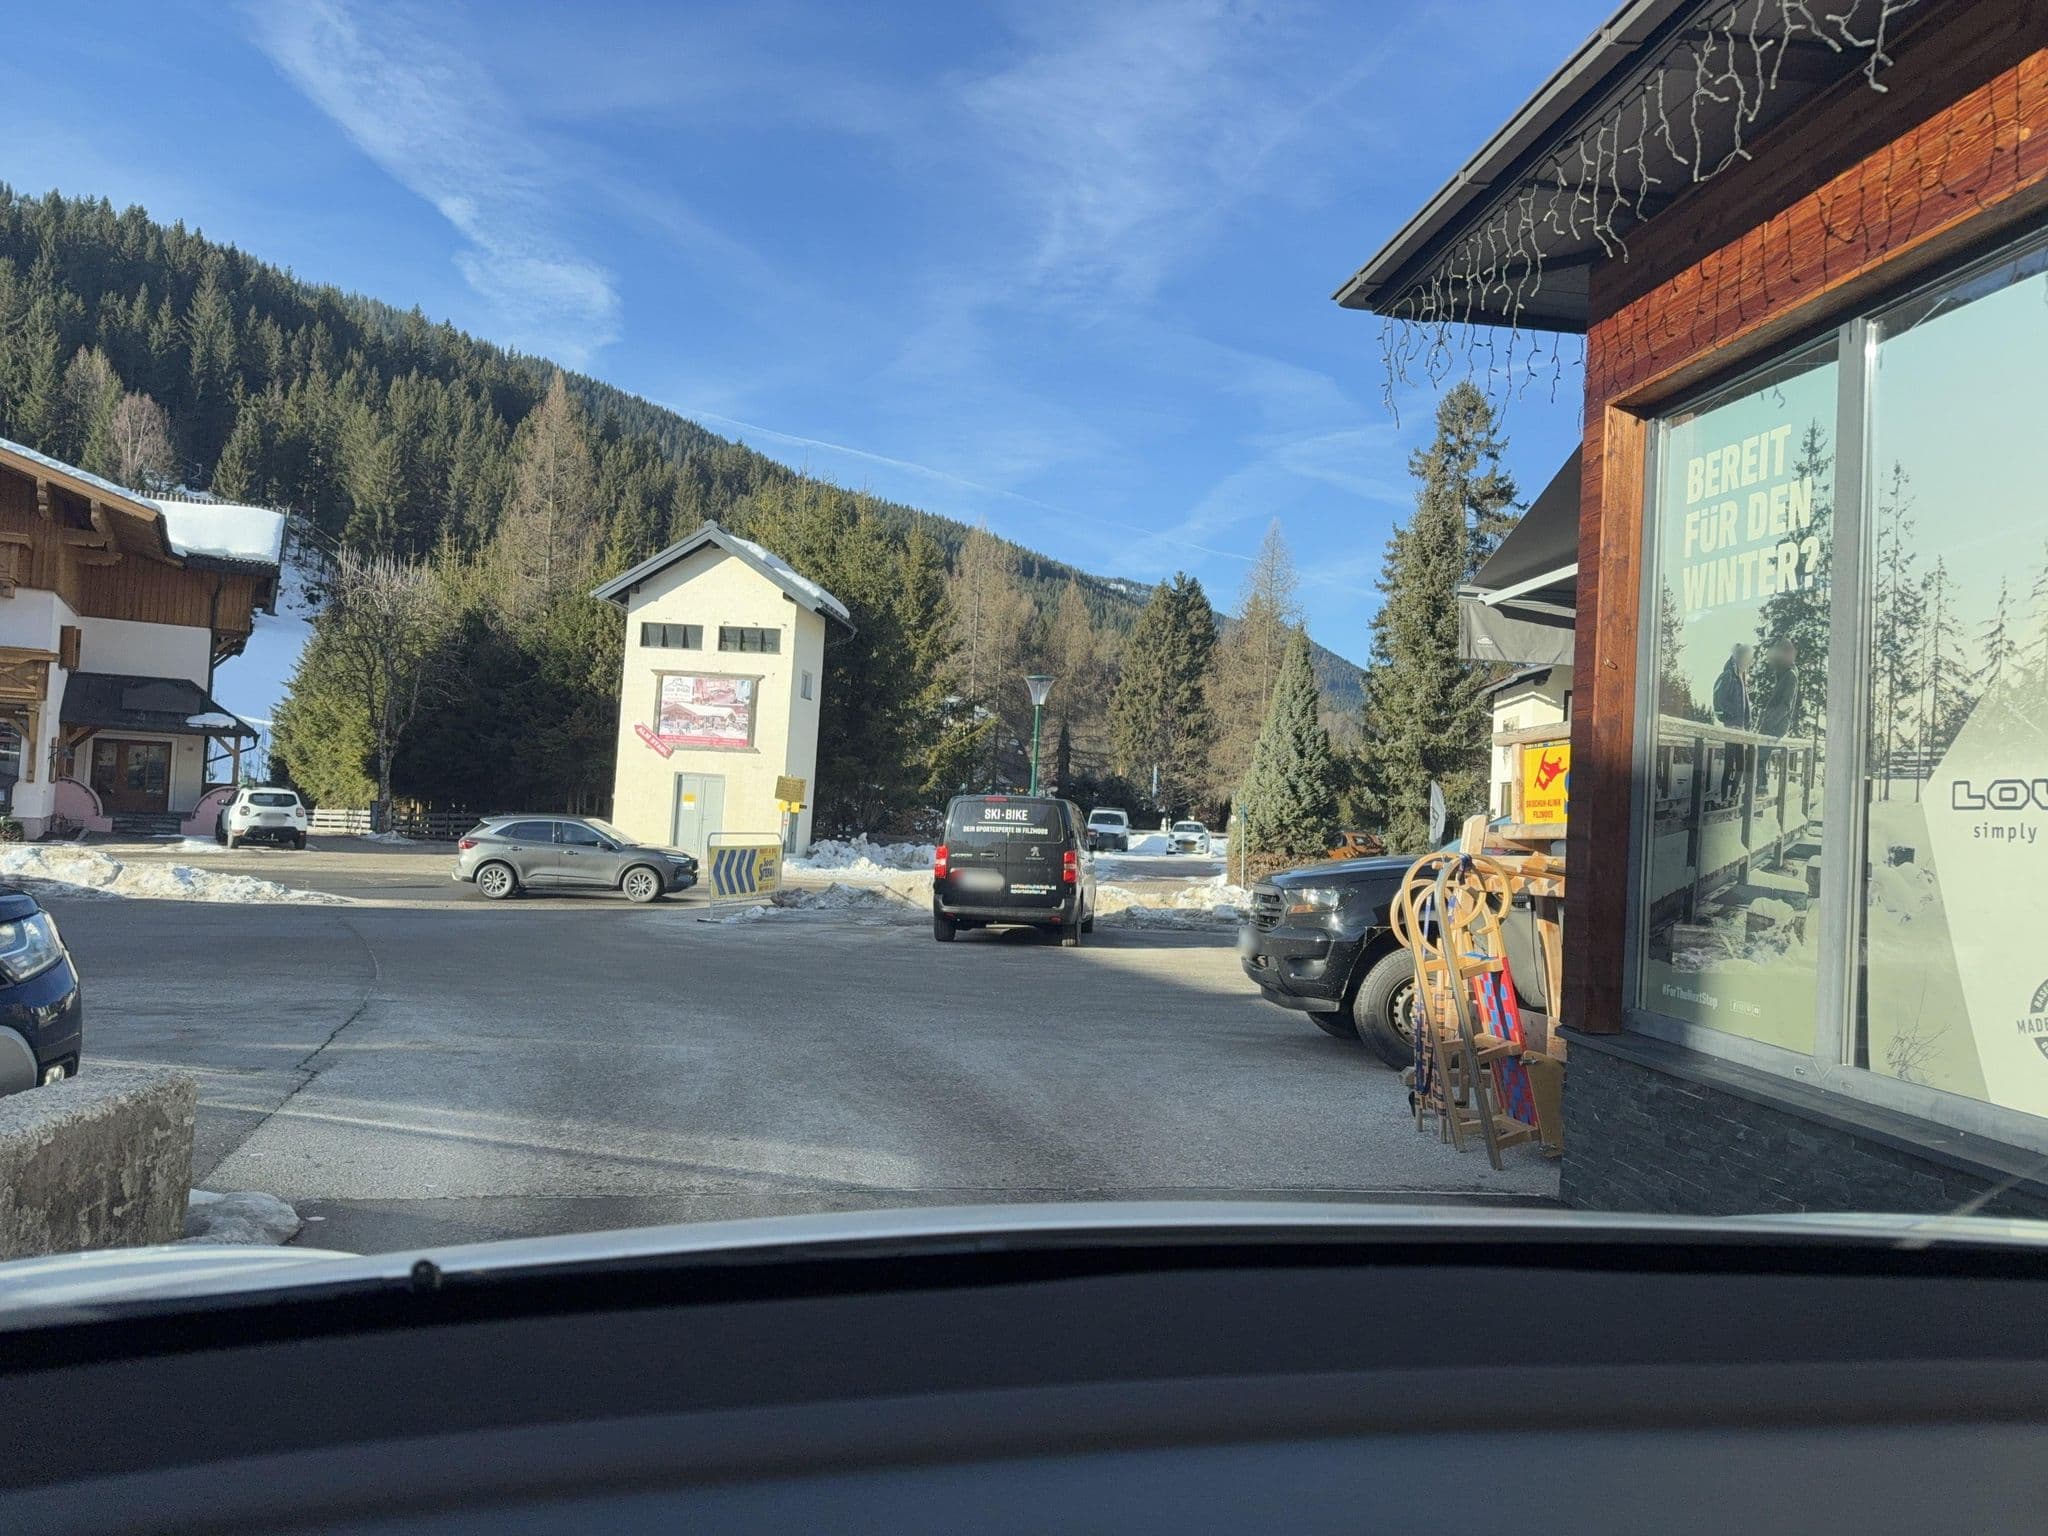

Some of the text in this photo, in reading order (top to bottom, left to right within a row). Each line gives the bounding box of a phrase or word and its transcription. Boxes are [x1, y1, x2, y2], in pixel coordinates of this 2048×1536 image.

[1686, 424, 1792, 505] BEREIT
[1684, 476, 1813, 559] FÜR DEN
[1683, 536, 1820, 613] WINTER?
[1973, 821, 2038, 844] simply
